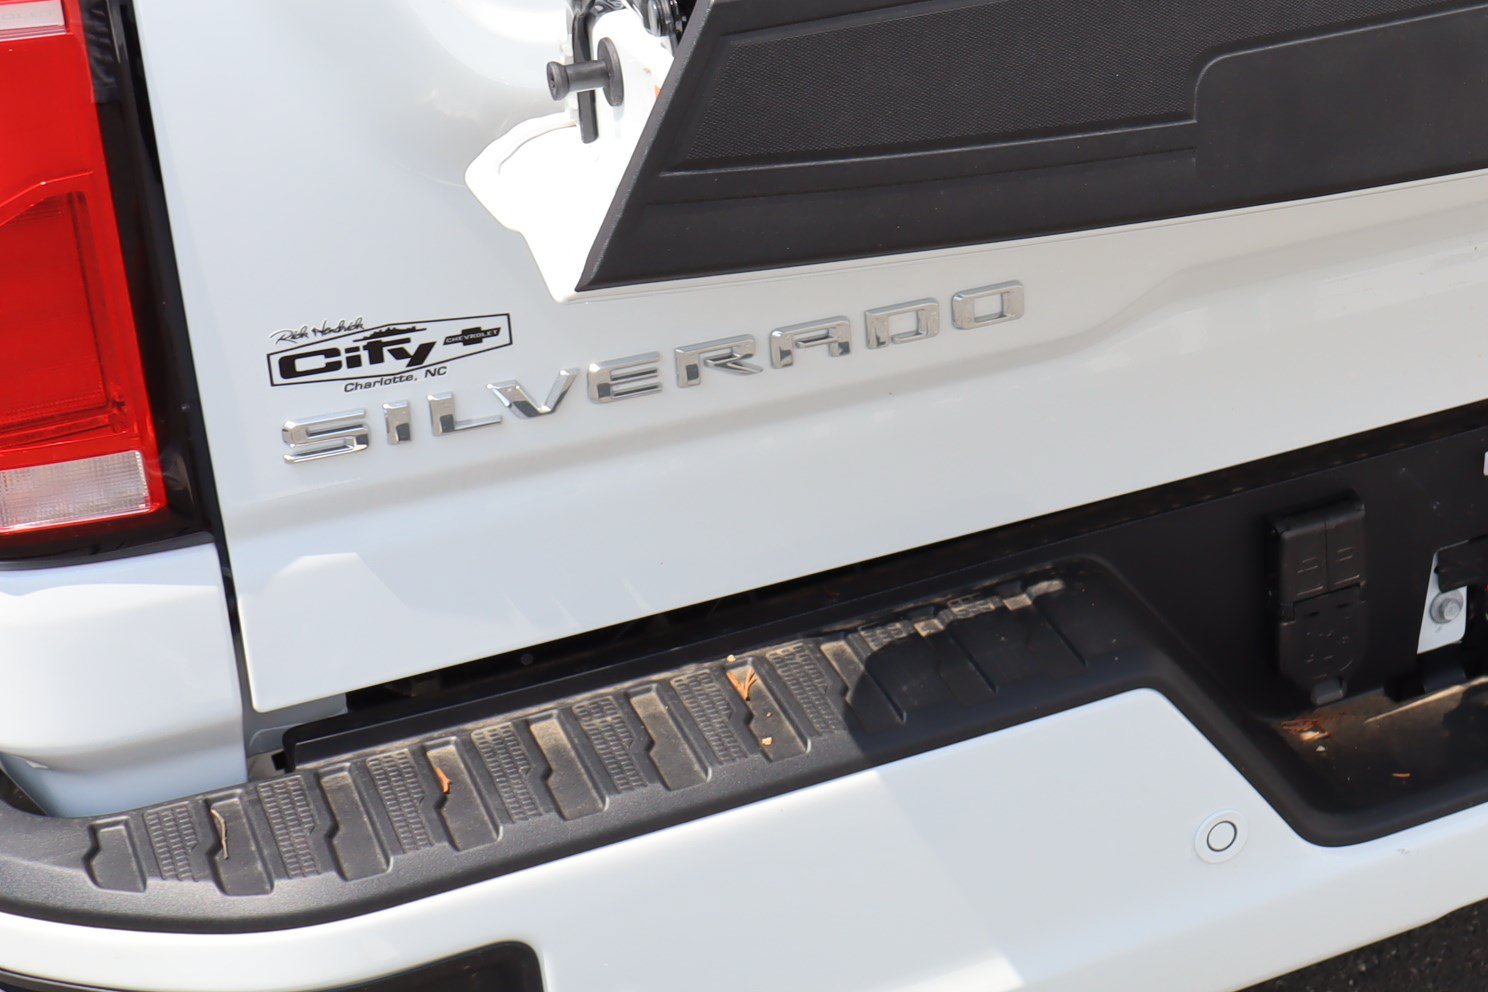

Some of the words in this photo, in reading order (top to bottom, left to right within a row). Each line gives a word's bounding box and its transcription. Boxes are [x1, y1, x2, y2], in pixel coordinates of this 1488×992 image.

[445, 329, 499, 344] CHEVROLET
[278, 339, 437, 380] City
[281, 279, 1027, 465] SILVERADO
[343, 374, 418, 393] Charlotte,
[424, 366, 448, 379] NC
